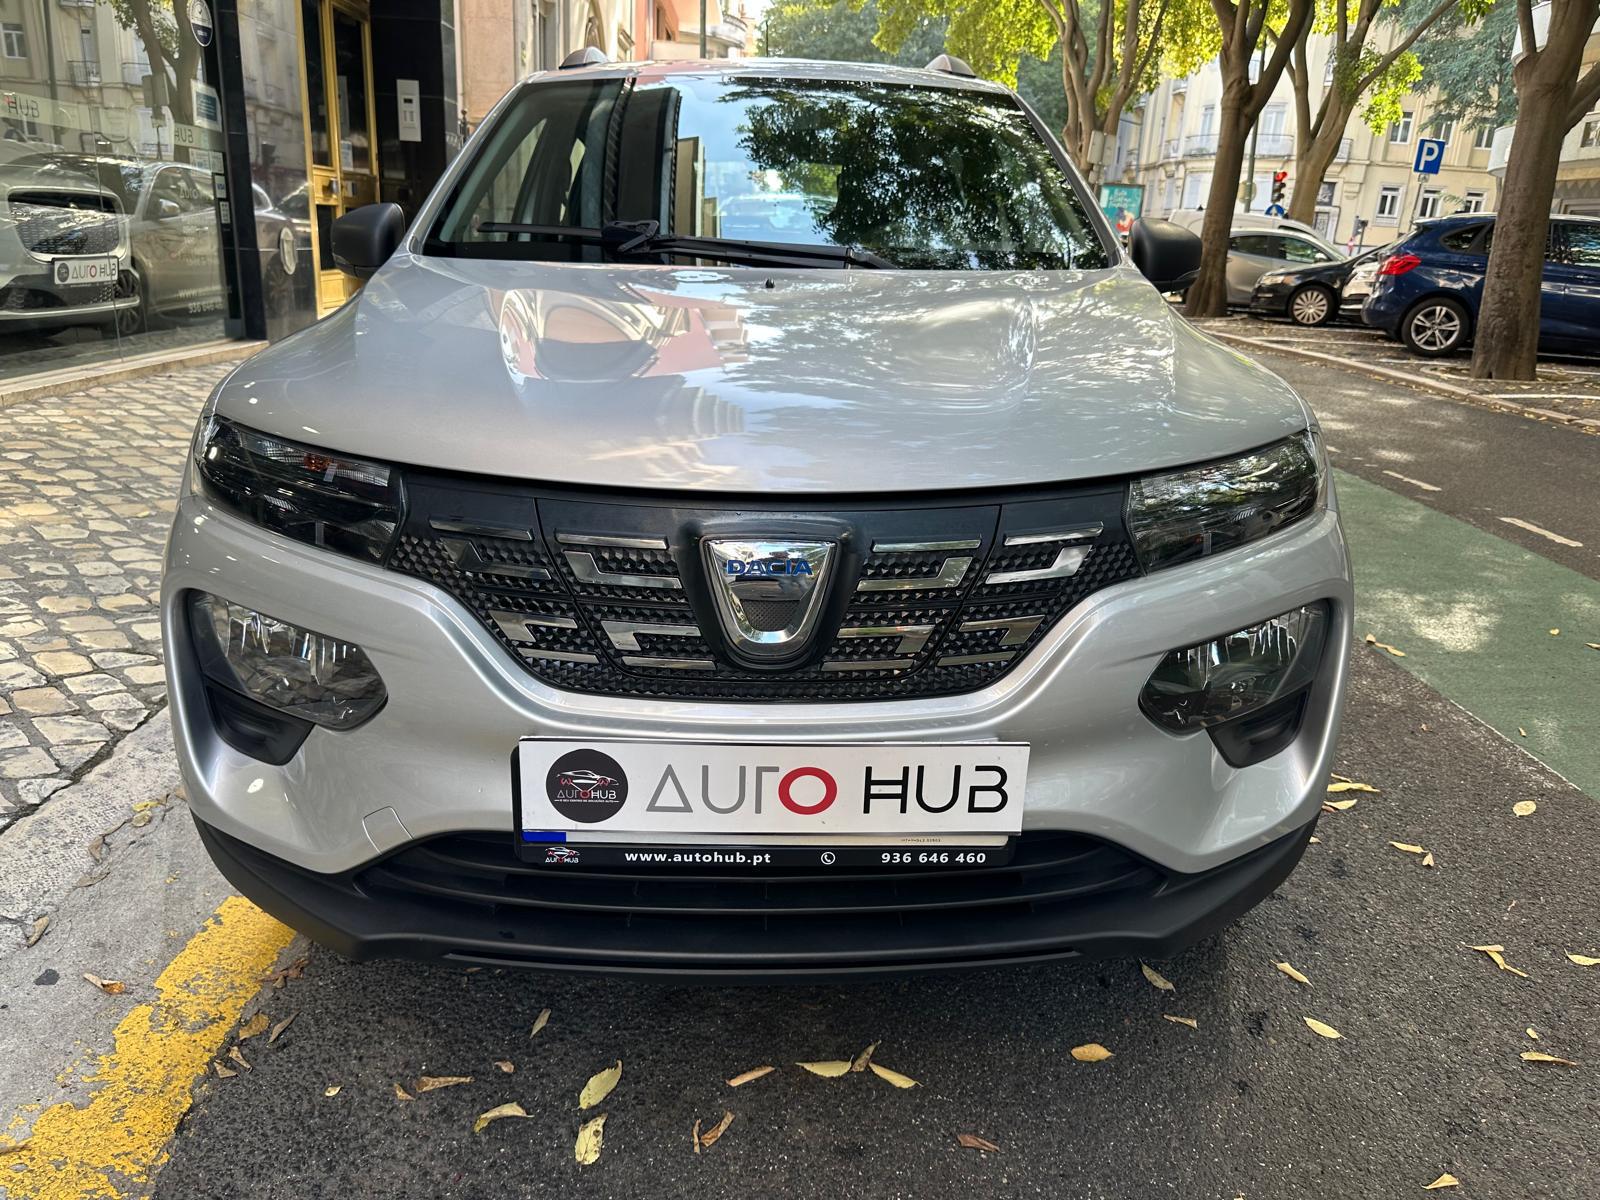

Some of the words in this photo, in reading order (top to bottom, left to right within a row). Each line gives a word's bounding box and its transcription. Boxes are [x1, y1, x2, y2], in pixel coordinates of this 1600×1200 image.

[8, 95, 40, 118] HUB
[1418, 141, 1439, 171] P
[71, 264, 98, 279] AUTO
[726, 559, 813, 576] DACIA
[645, 763, 838, 815] AUTO
[863, 763, 1009, 815] HUB
[624, 851, 771, 866] www.autohub.pt
[881, 852, 912, 864] 936
[918, 852, 949, 864] 646
[955, 852, 987, 864] 460
